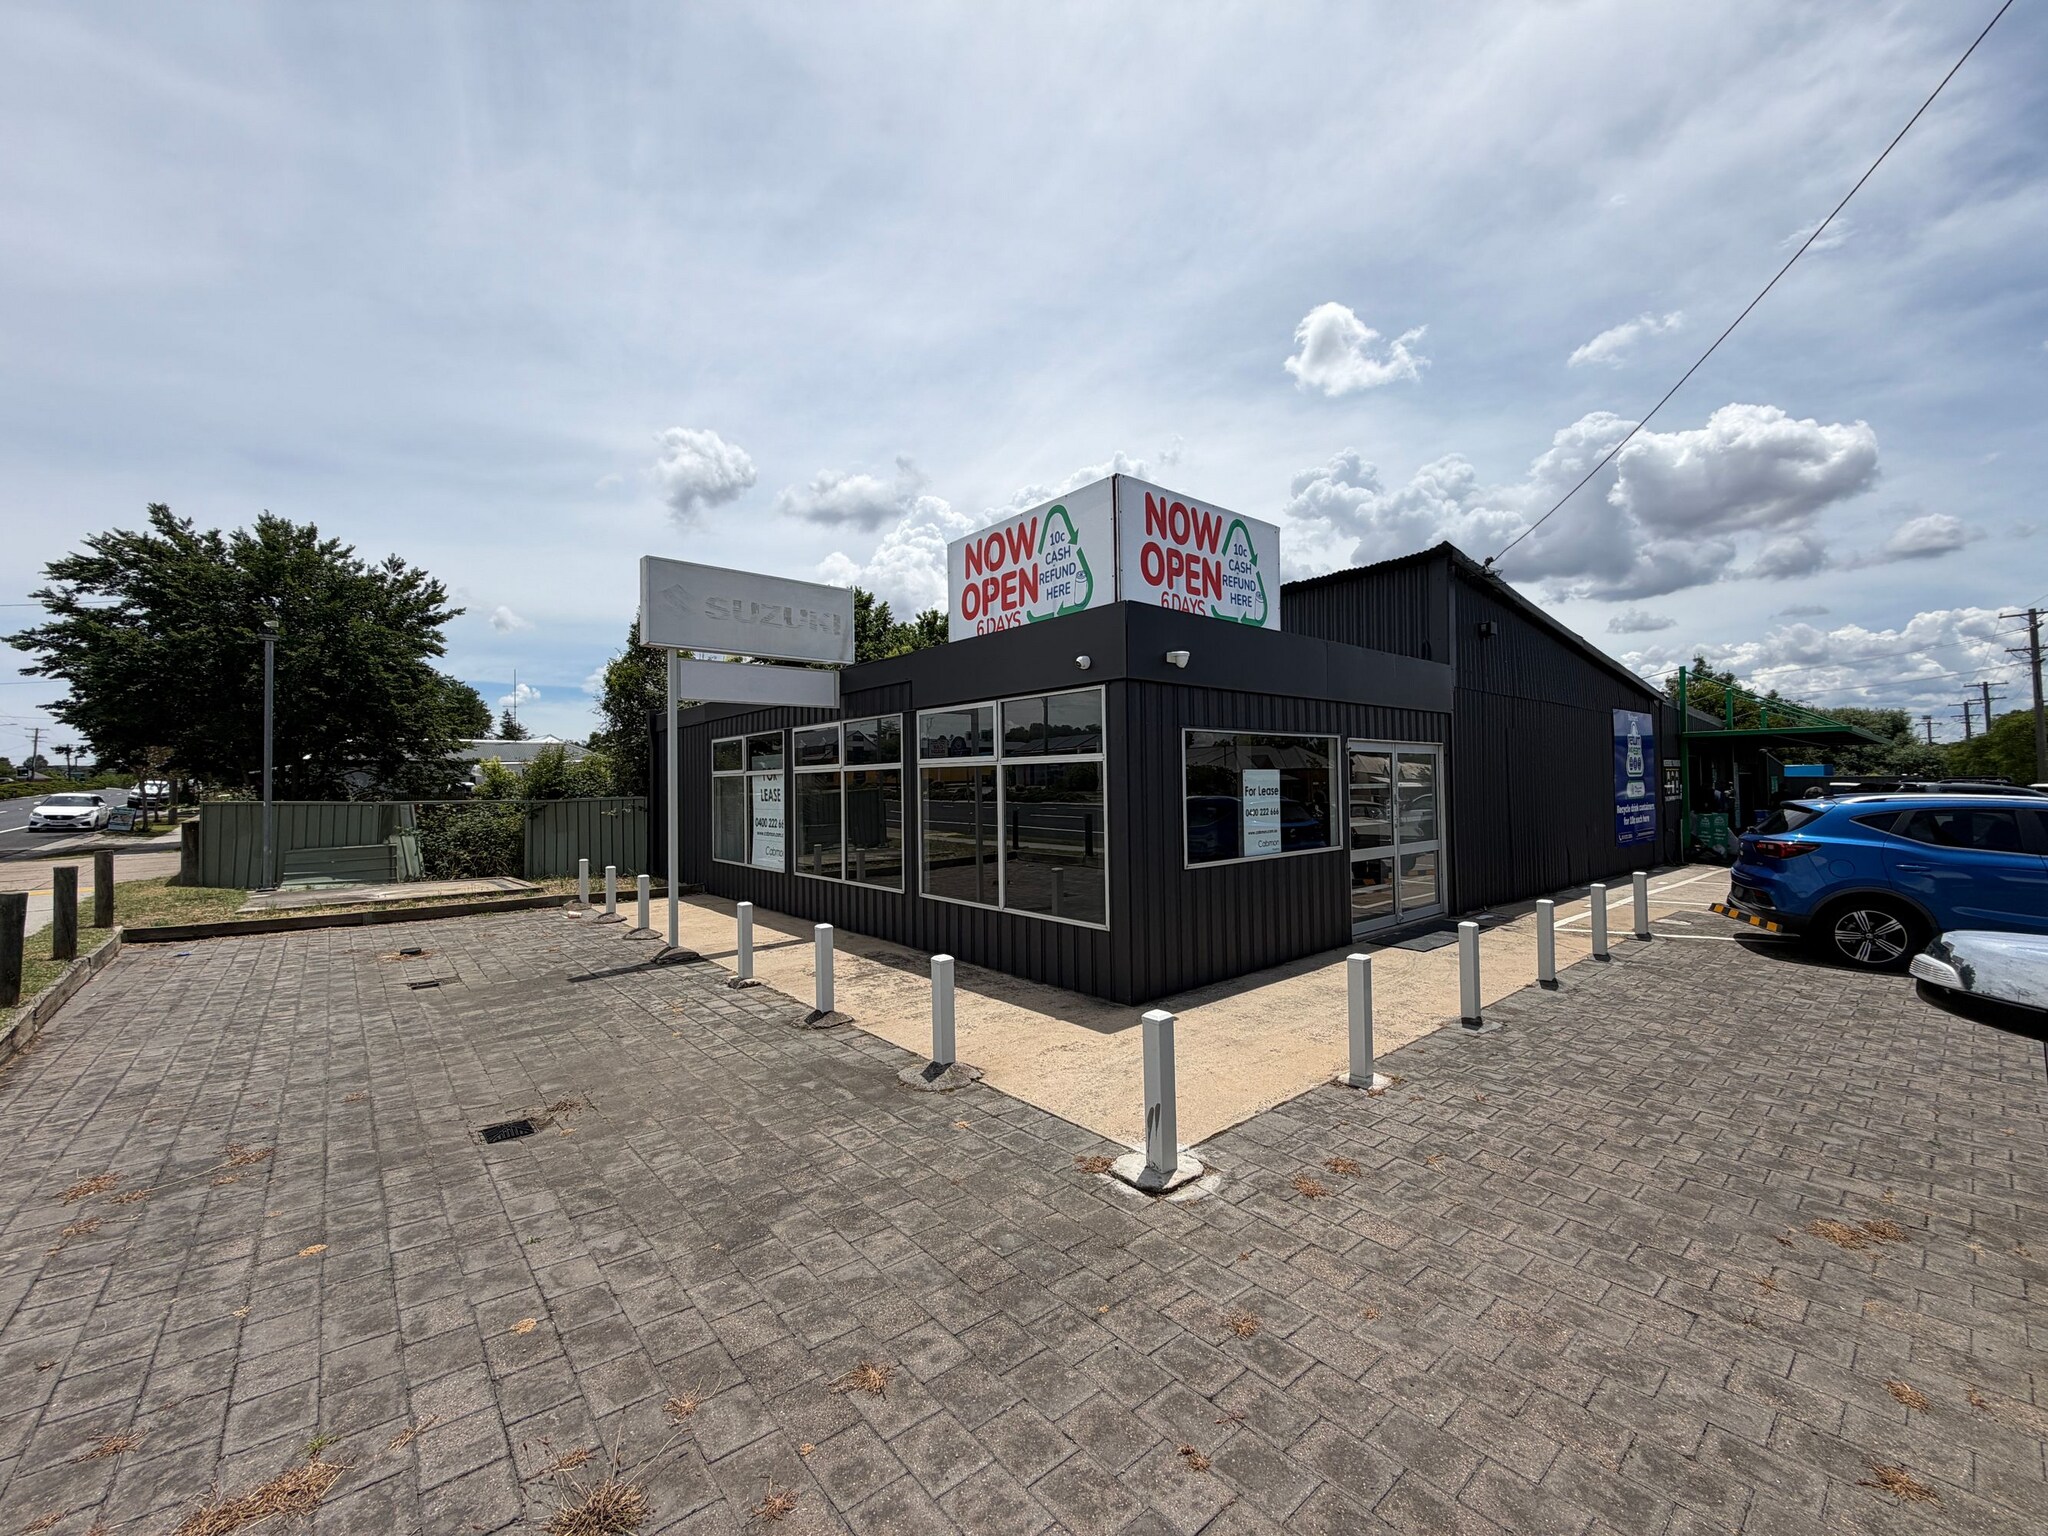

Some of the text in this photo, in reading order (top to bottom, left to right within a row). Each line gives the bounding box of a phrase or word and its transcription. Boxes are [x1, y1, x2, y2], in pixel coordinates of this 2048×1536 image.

[1145, 491, 1223, 555] NOW
[965, 516, 1038, 580] NOW
[1050, 531, 1065, 546] 10c
[1045, 545, 1071, 566] CASH
[1233, 543, 1248, 557] 10c
[1039, 562, 1077, 586] REFUND
[1140, 541, 1223, 601] OPEN
[1228, 559, 1252, 575] CASH
[962, 562, 1039, 621] OPEN
[1046, 581, 1071, 601] HERE
[1222, 574, 1256, 592] REFUND
[1161, 591, 1207, 616] 6 DAYS
[1230, 592, 1253, 608] HERE
[704, 597, 841, 636] SUZUKI
[977, 610, 1022, 637] 6 DAYS
[760, 788, 781, 802] LEASE
[1245, 785, 1279, 797] For Lease
[1259, 807, 1269, 816] 222
[1270, 807, 1279, 816] 666
[768, 818, 777, 828] 222
